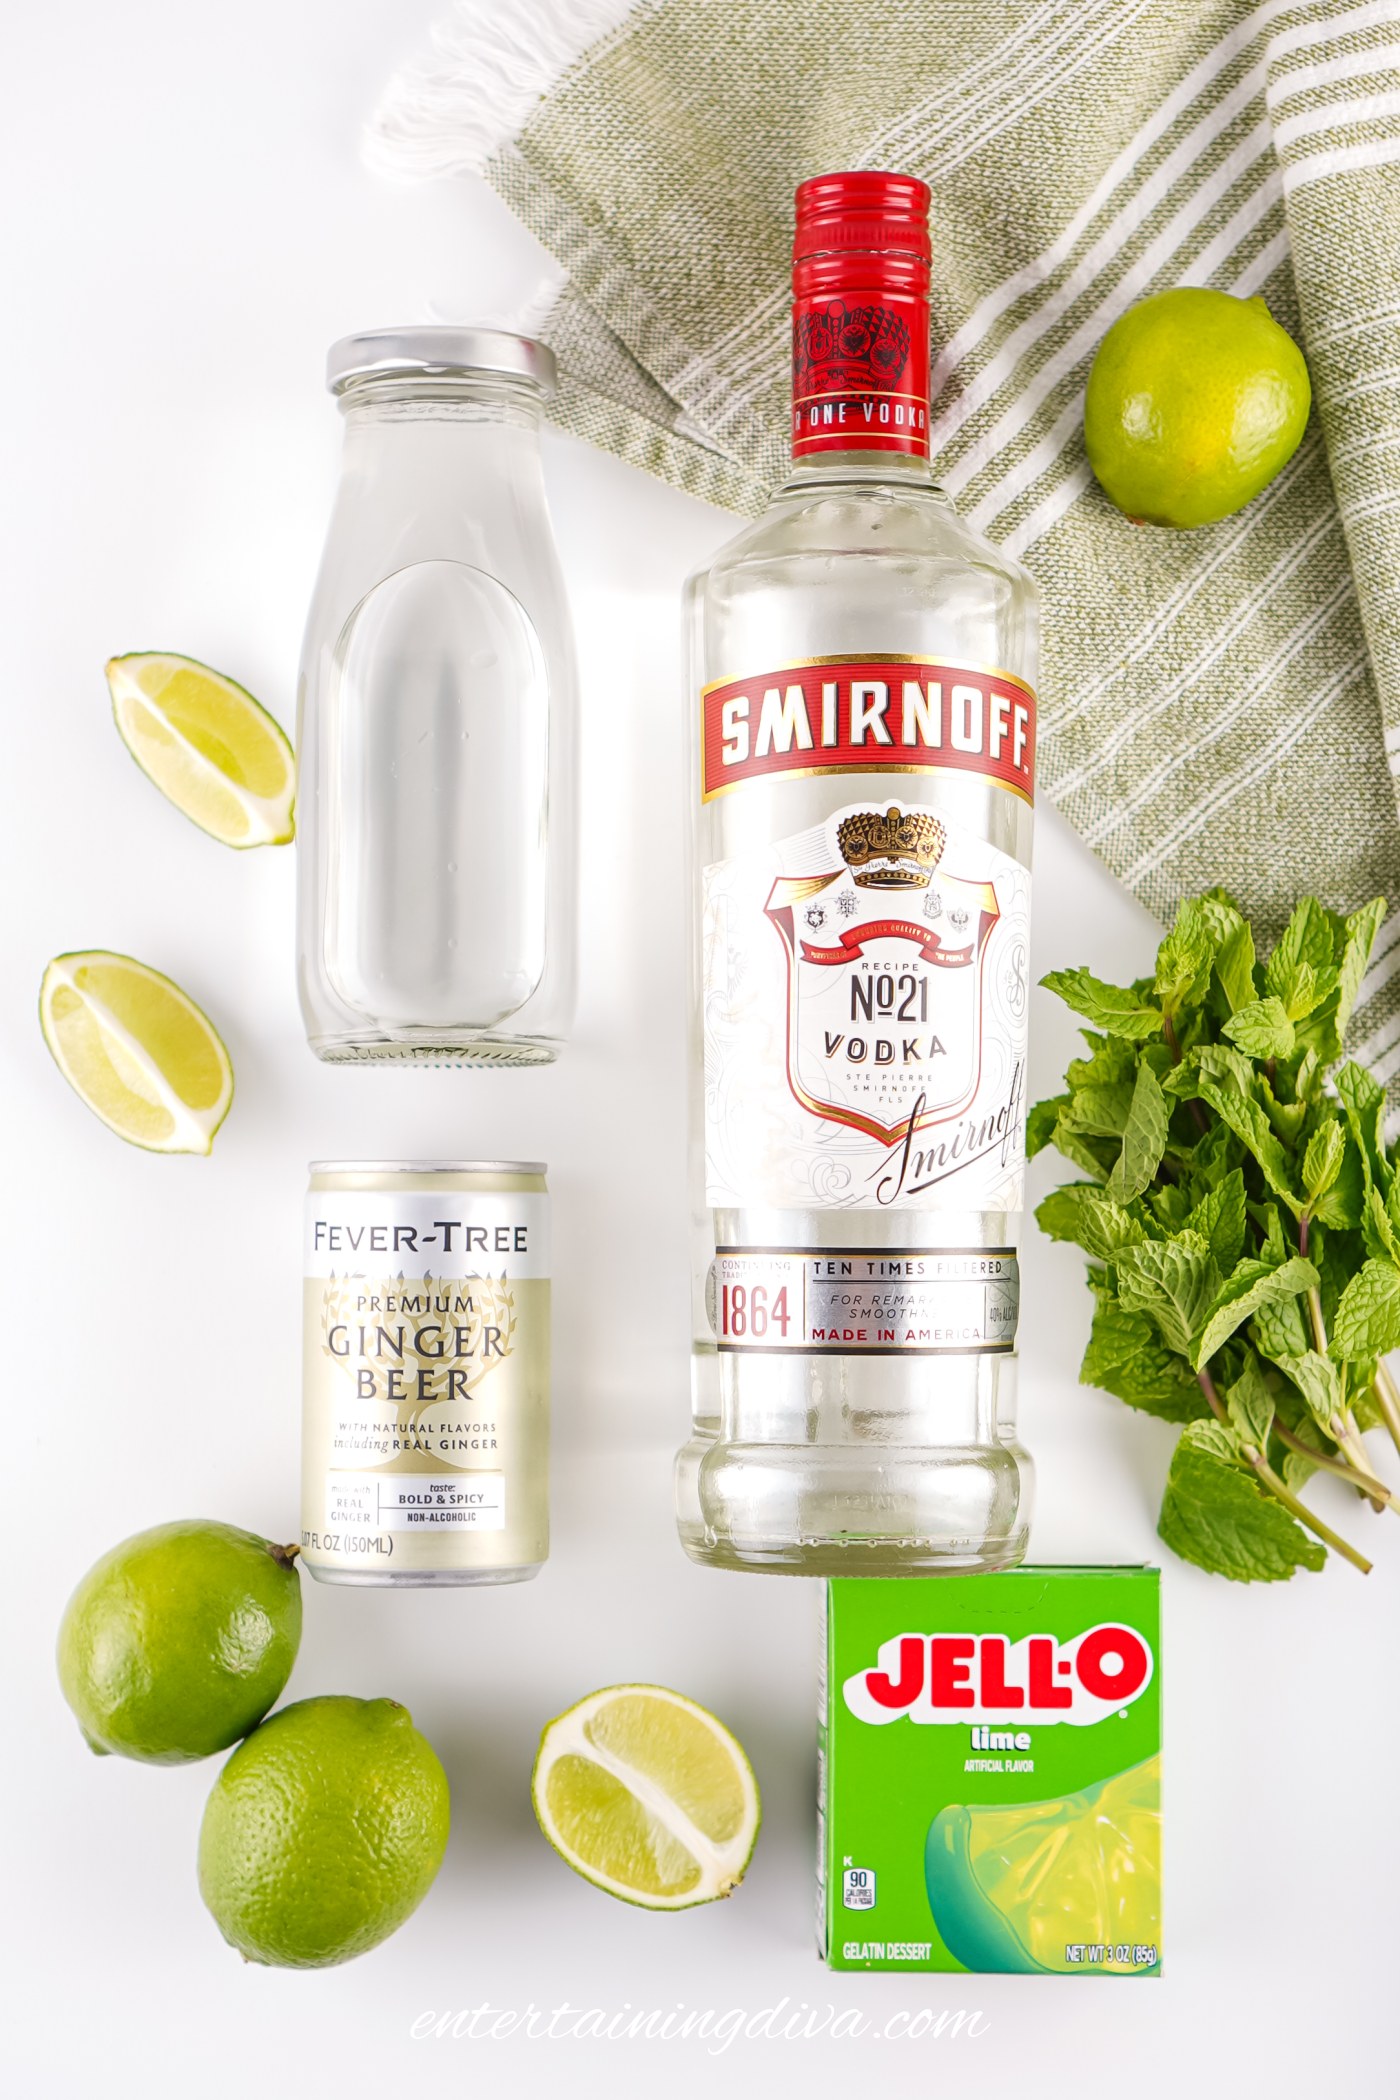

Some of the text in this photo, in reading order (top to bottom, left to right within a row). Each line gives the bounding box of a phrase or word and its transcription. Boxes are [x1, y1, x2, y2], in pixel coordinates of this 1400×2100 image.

[810, 402, 846, 426] ONE
[863, 402, 925, 429] VODKA
[721, 680, 1029, 769] SMIRNOFF
[862, 962, 919, 972] RECIPE
[824, 1031, 947, 1066] VODKA
[846, 1073, 932, 1082] STE PIERRE
[864, 1057, 1025, 1205] Smirnoff
[314, 1221, 528, 1252] FEVER-TREE
[814, 1261, 1002, 1275] TEN TIMES FILTERED
[356, 1296, 474, 1313] PREMIUM
[830, 1294, 862, 1305] FOR
[722, 1284, 791, 1337] 1864
[328, 1325, 507, 1357] GINGER
[812, 1328, 980, 1341] MADE IN AMERICA
[356, 1369, 473, 1400] BEER
[339, 1423, 496, 1433] WITH NATURAL FLAVORS
[334, 1436, 498, 1453] including REAL GINGER
[336, 1498, 364, 1508] REAL
[398, 1494, 484, 1504] BOLD & SPICY
[330, 1511, 371, 1522] GINGER
[407, 1512, 477, 1522] NON-ALCOHOLIC
[311, 1533, 321, 1549] FL
[323, 1534, 341, 1551] OZ
[344, 1534, 394, 1557] (150ML)
[970, 1725, 1031, 1751] lime
[964, 1759, 1034, 1772] ARTIFICIAL FLAVOR
[843, 1855, 853, 1866] K
[850, 1871, 867, 1887] 90
[842, 1942, 932, 1960] GELATIN DESSERT
[1066, 1944, 1157, 1967] NET WT 3 OZ (85g)
